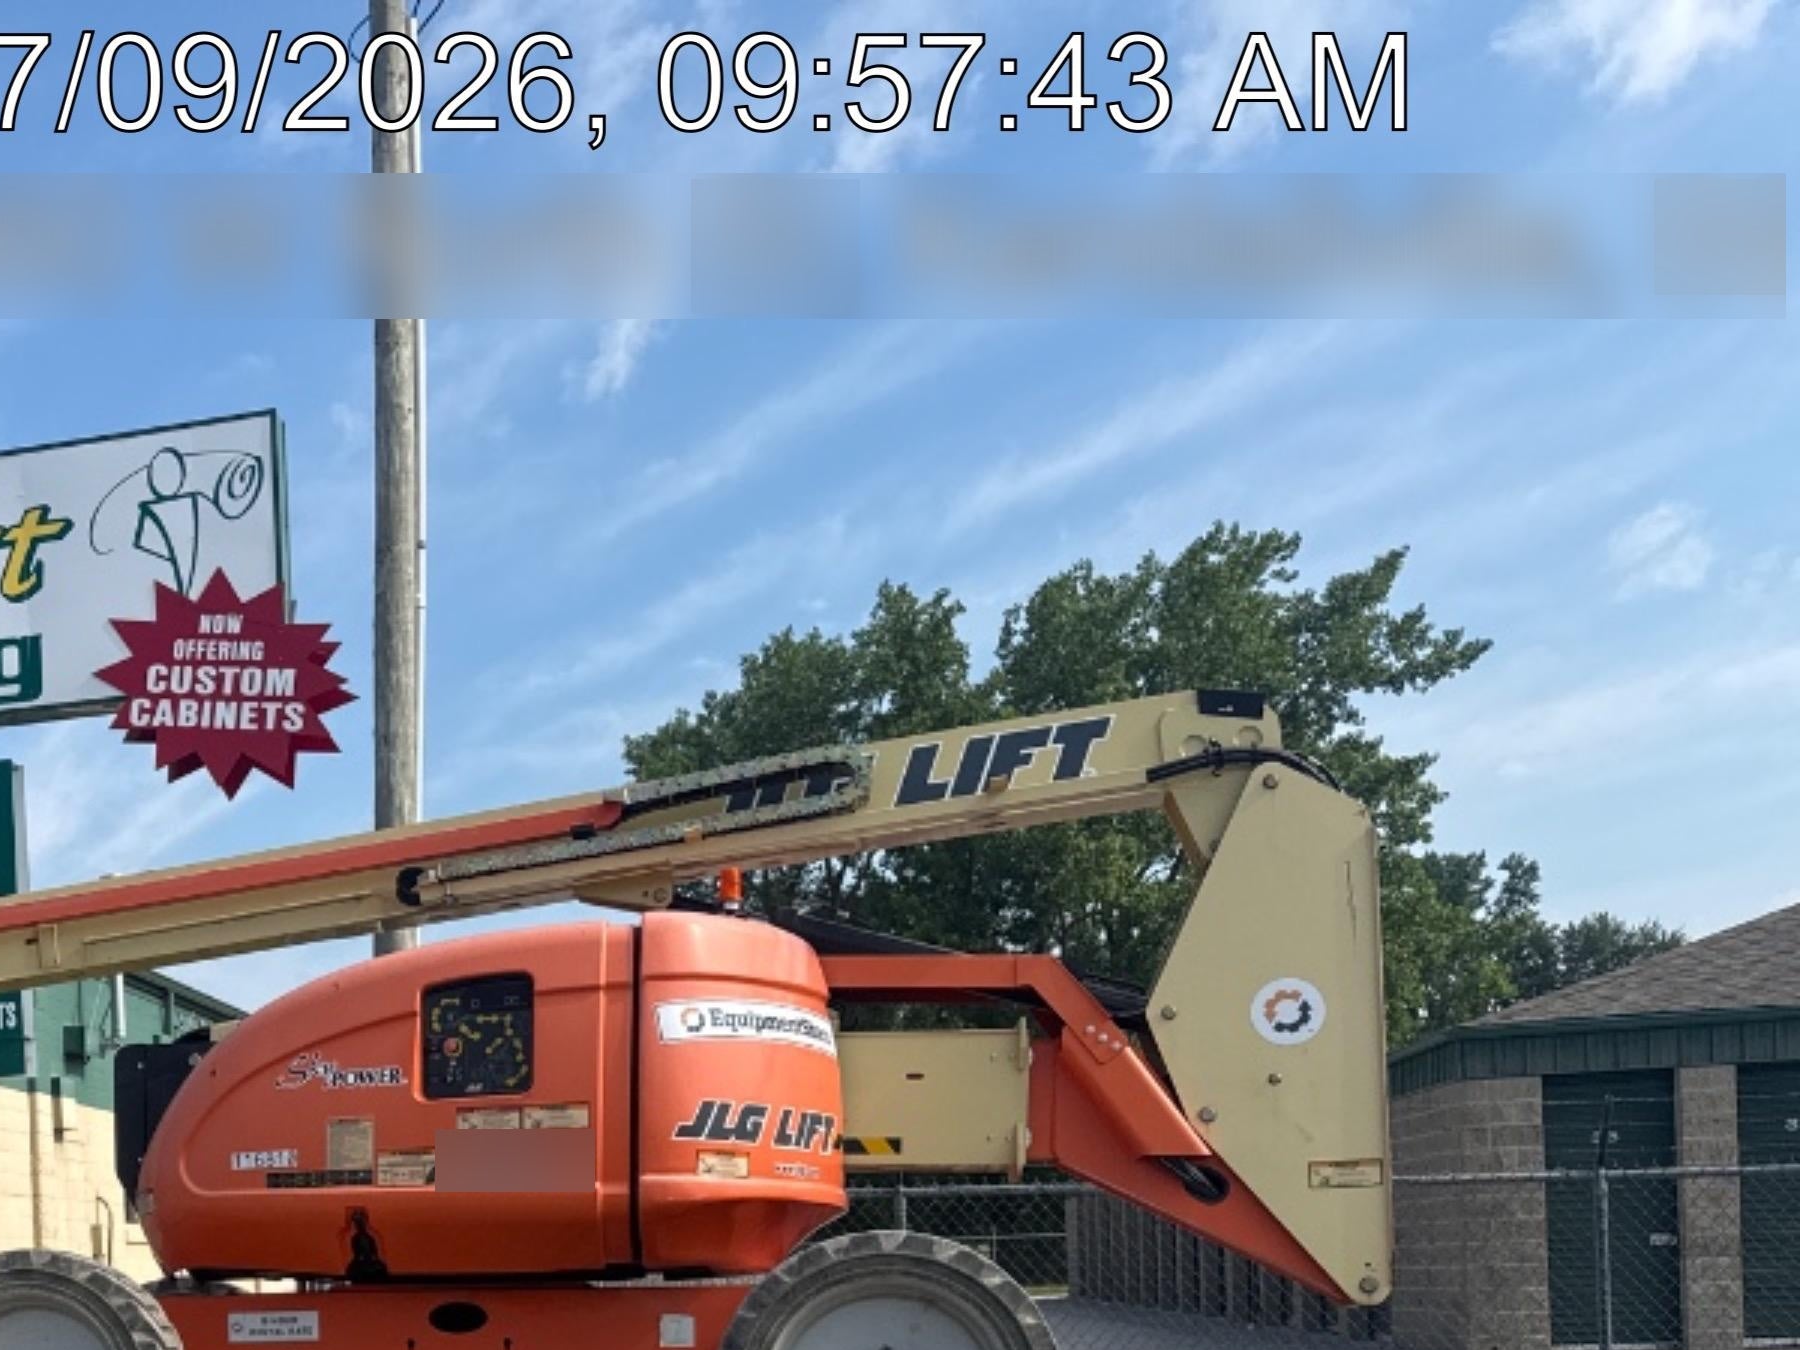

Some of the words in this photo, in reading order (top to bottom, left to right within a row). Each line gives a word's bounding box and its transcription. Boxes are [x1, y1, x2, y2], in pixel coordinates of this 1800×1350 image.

[197, 613, 245, 635] NOW
[172, 638, 265, 662] OFFERING
[145, 663, 298, 698] CUSTOM
[128, 697, 307, 732] CABINETS
[894, 714, 1117, 808] LIFT
[672, 1098, 771, 1146] JLG
[771, 1107, 838, 1156] LIFT
